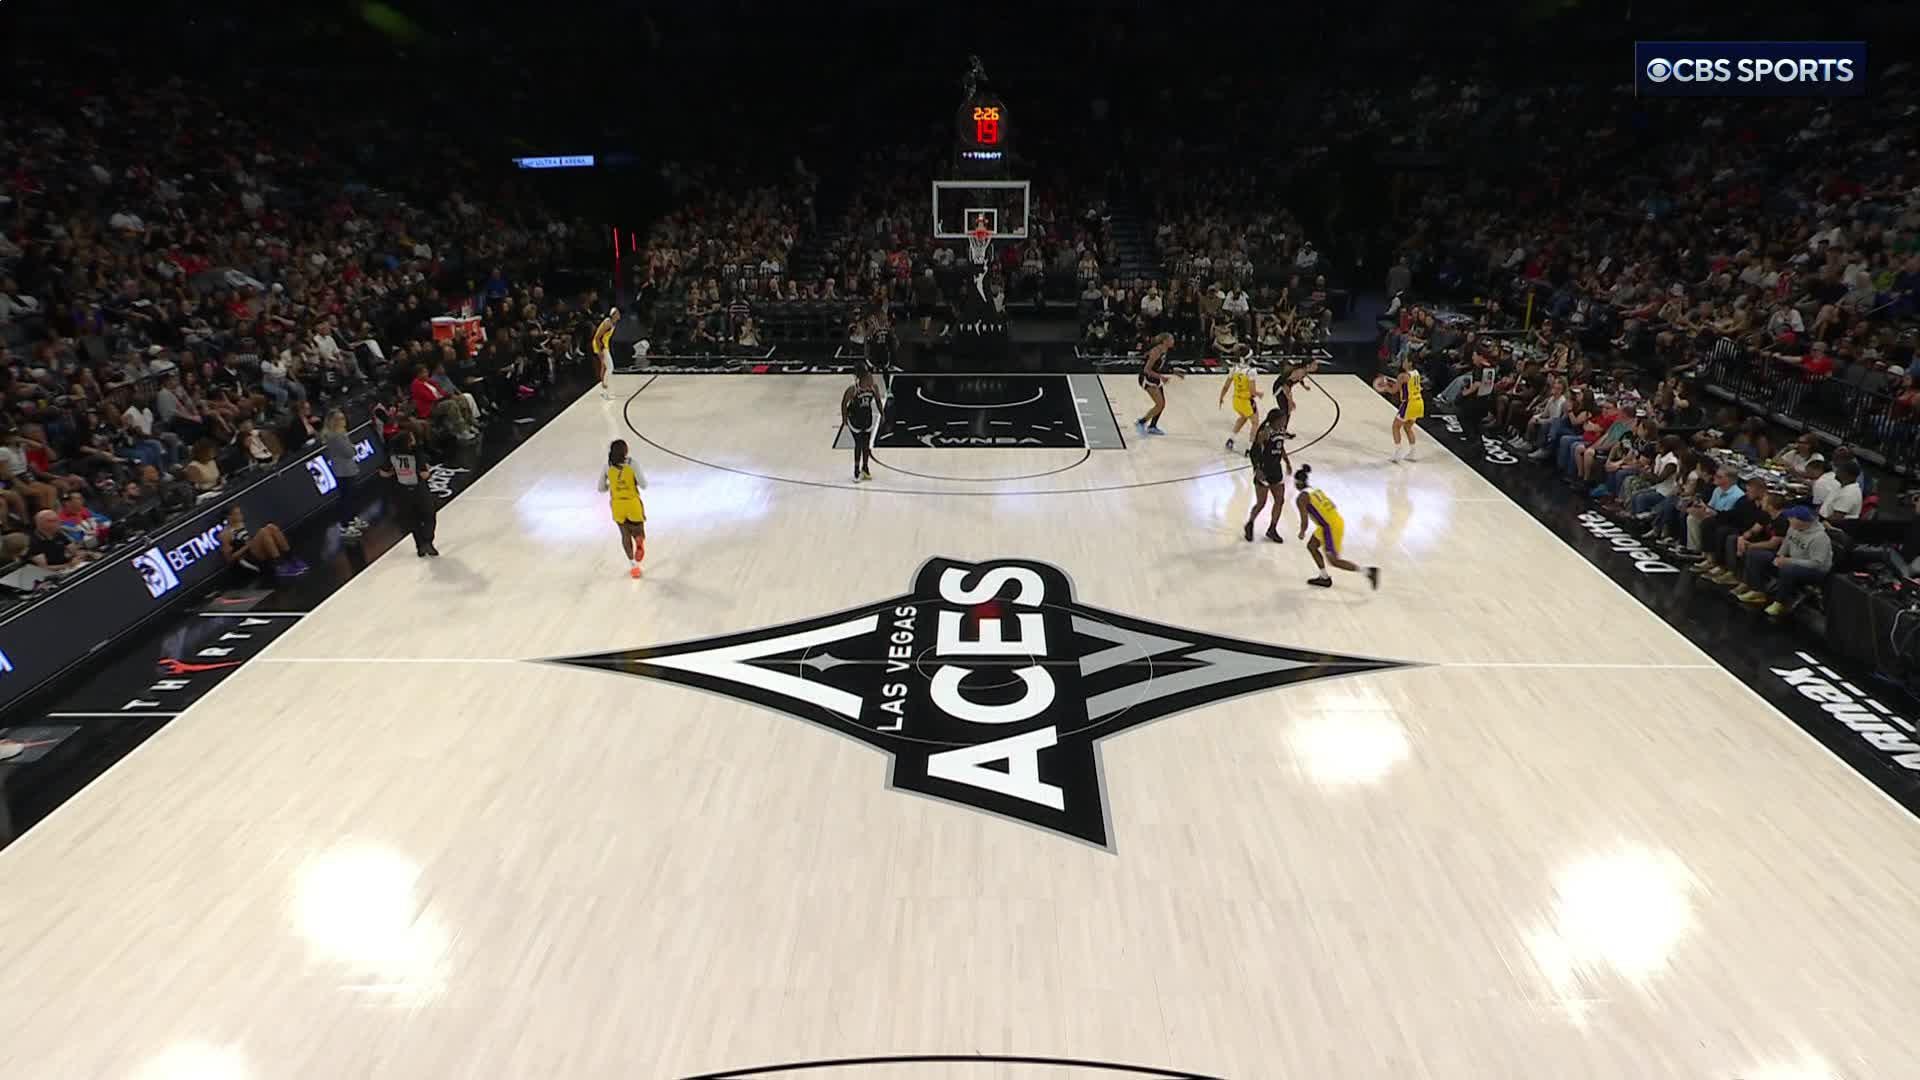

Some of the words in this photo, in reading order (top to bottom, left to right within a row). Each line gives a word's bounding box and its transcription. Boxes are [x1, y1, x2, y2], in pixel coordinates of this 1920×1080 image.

[974, 106, 999, 120] 2:26
[977, 119, 998, 145] 19
[974, 151, 1002, 160] TISSOT
[939, 437, 1042, 445] WNBA
[886, 605, 917, 673] VEGAS
[927, 566, 1065, 812] ACES
[877, 684, 909, 731] LAS
